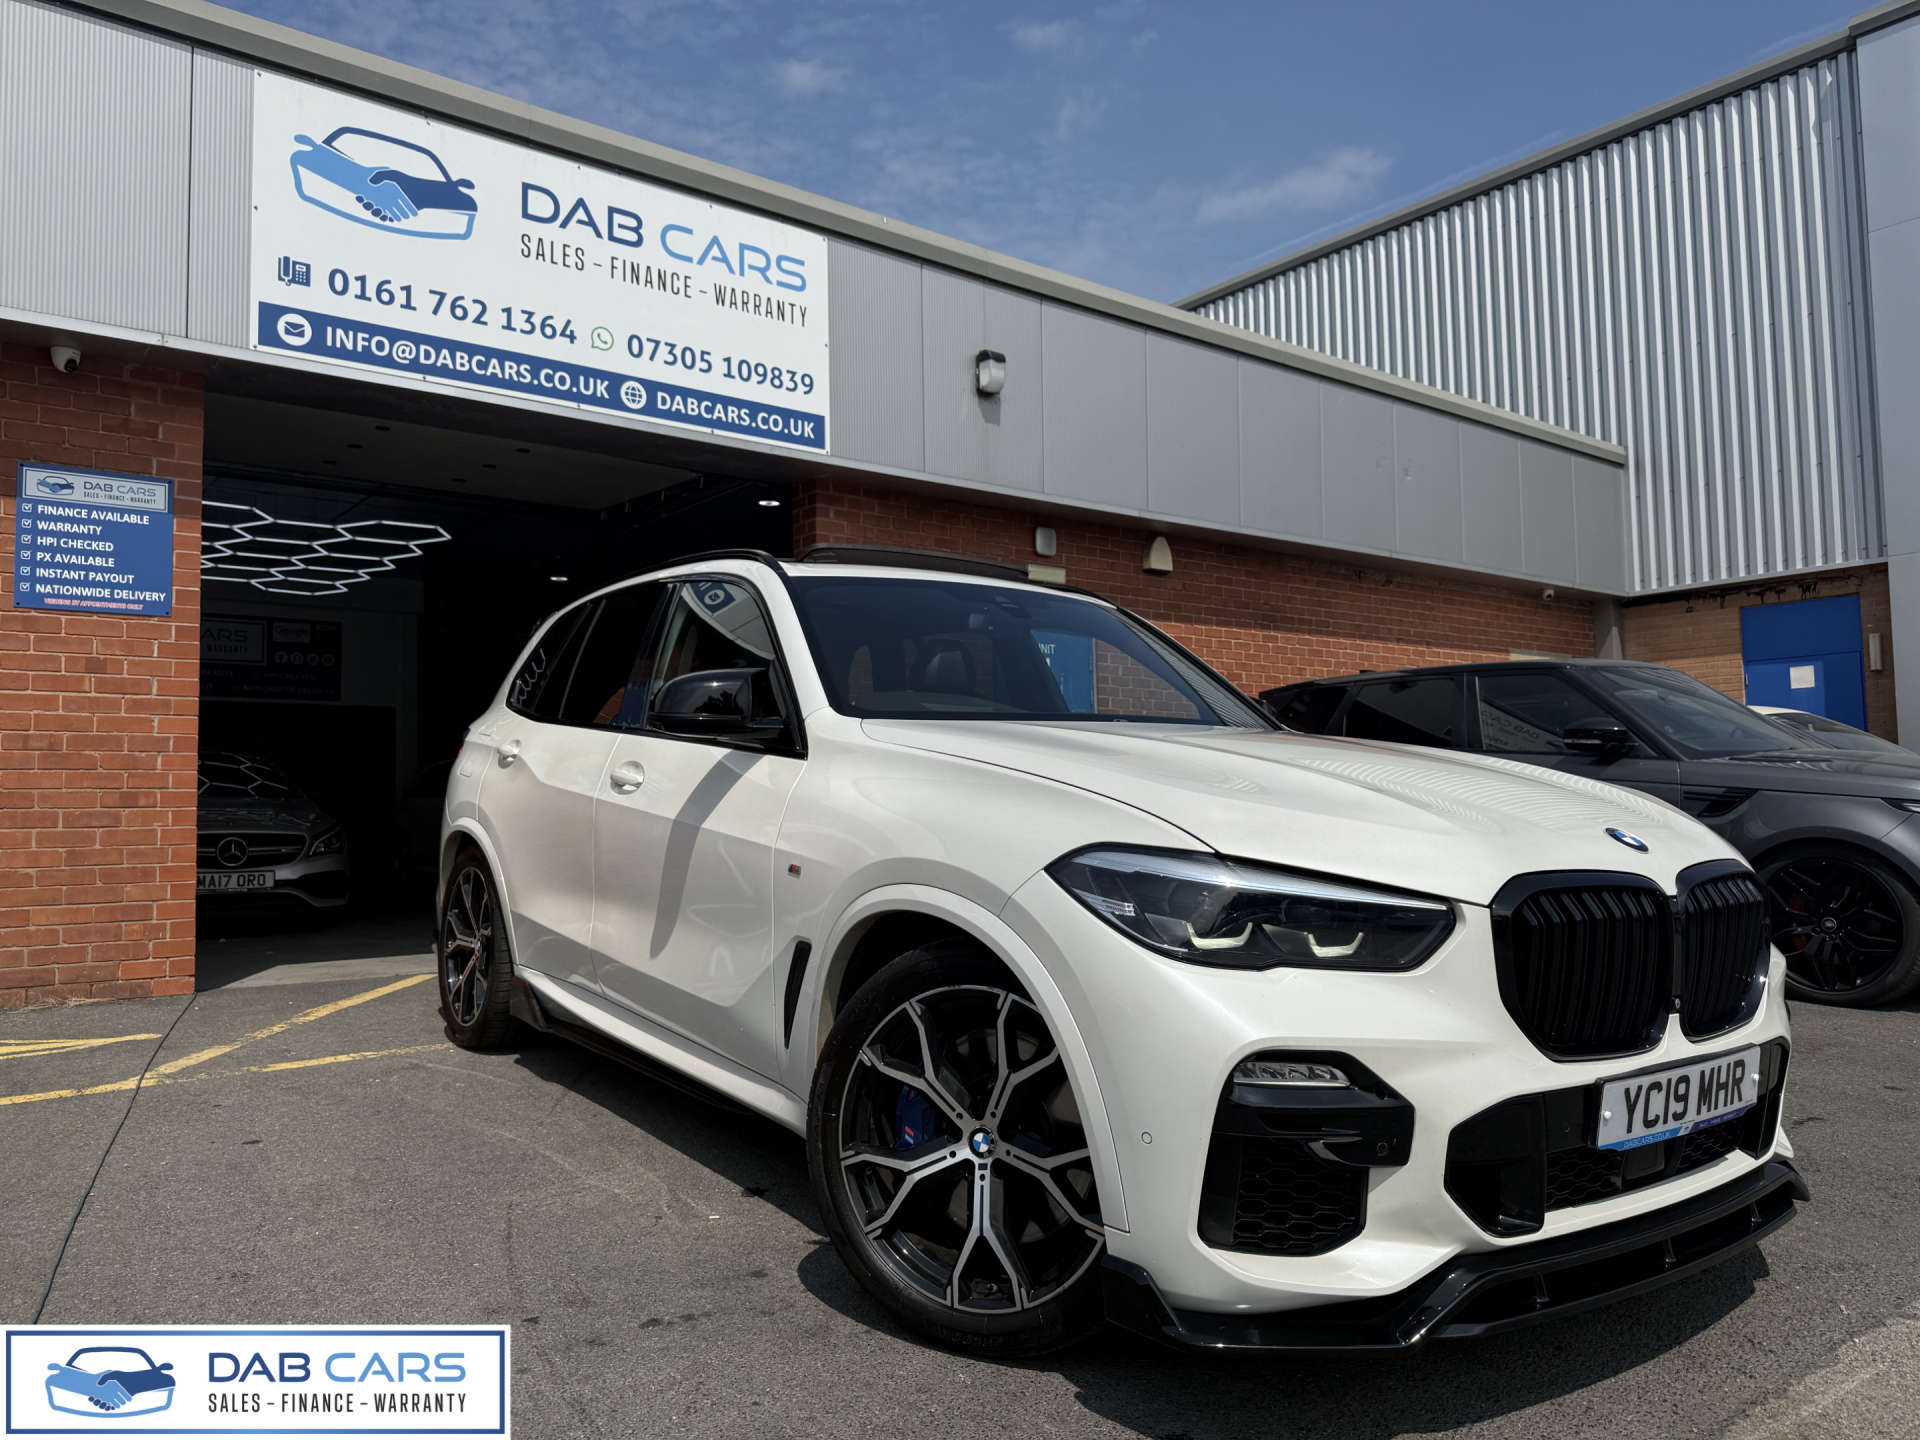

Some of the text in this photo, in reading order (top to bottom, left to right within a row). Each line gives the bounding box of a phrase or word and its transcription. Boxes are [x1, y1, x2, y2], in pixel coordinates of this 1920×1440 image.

[521, 181, 807, 293] DAB CARS
[520, 233, 585, 272] SALES
[610, 256, 692, 299] FINANCE
[714, 283, 807, 328] WARRANTY
[328, 268, 577, 345] 0161 762 1364
[326, 326, 610, 400] INFO@DABCARS.CO.UK
[627, 334, 814, 395] 07305 109839
[656, 391, 815, 439] DABCARS.CO.UK
[83, 481, 157, 498] DAB CARS
[37, 505, 150, 525] FINANCE AVAILABLE
[36, 519, 102, 535] WARRANTY
[37, 536, 114, 552] HPI CHECKED
[36, 551, 115, 567] PX AVAILABLE
[36, 567, 135, 585] INSTANT PAYOUT
[35, 583, 166, 602] NATIONWIDE DELIVERY
[201, 627, 249, 643] ARS
[1624, 1058, 1746, 1134] YC19 MHR
